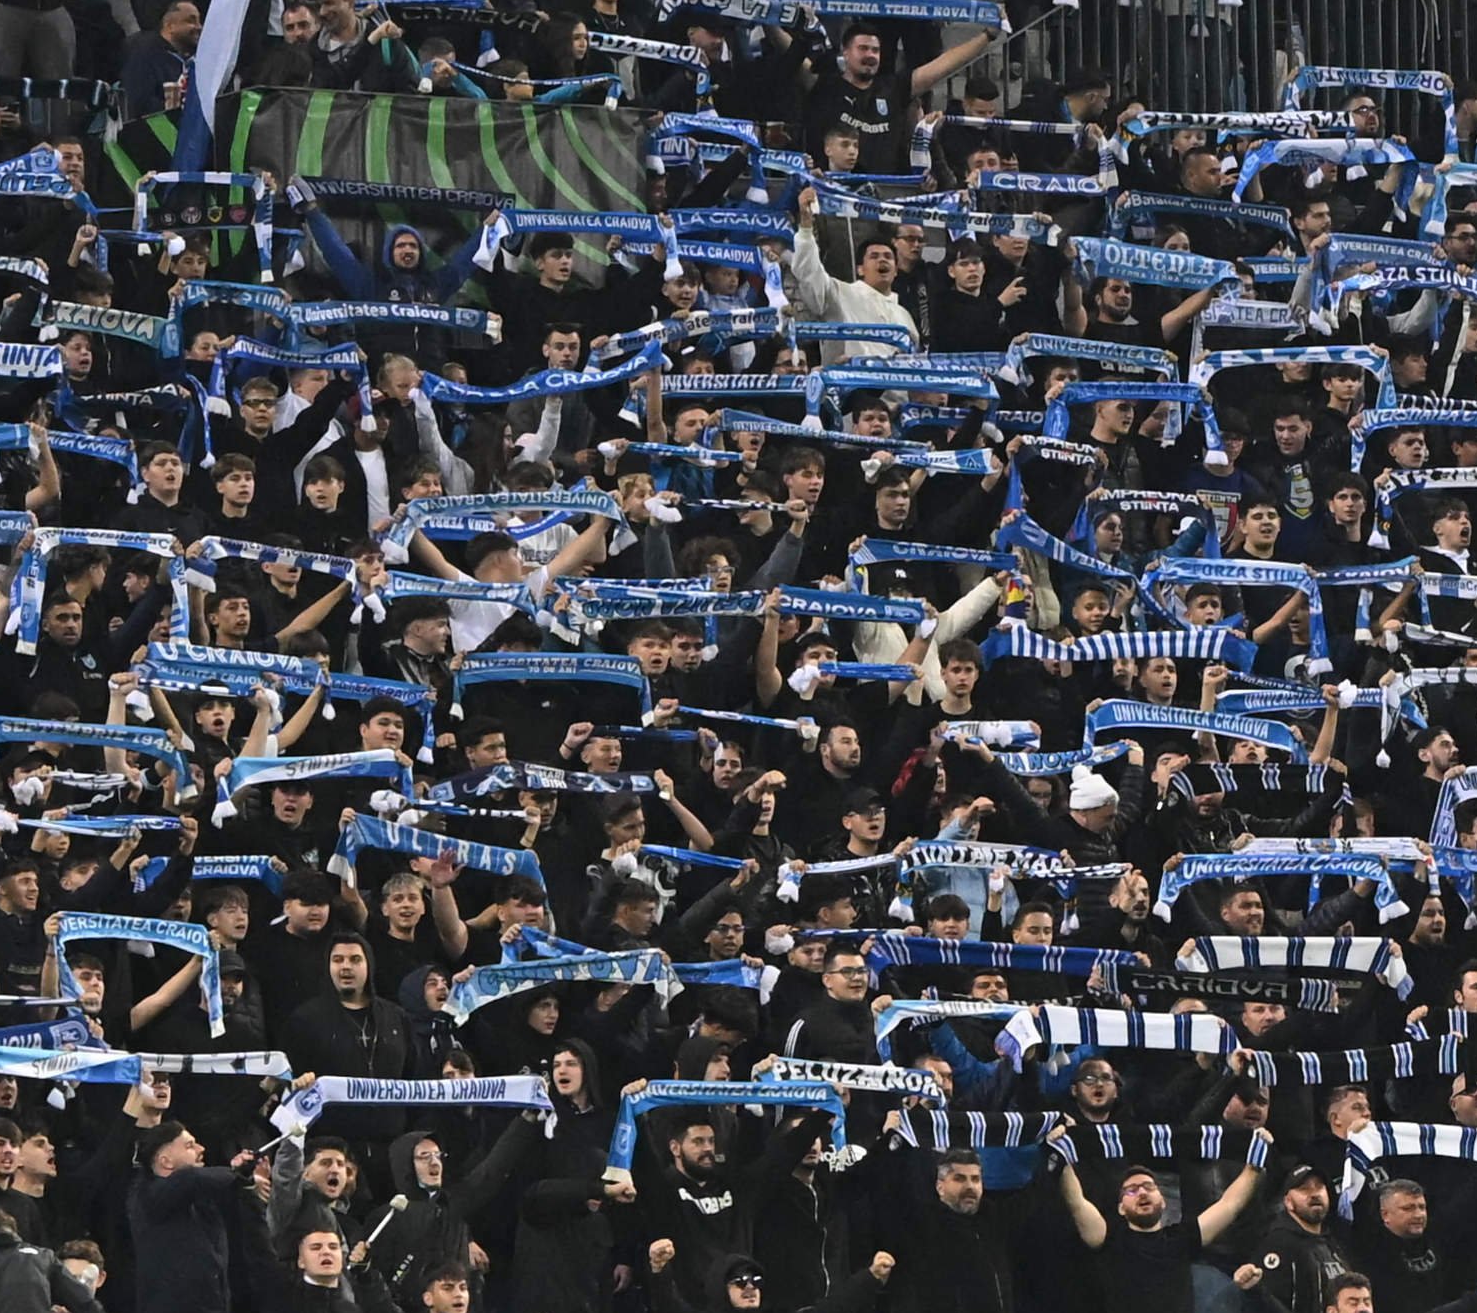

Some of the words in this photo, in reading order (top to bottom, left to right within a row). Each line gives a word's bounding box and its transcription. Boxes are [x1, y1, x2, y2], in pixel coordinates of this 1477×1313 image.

[991, 172, 1105, 192] CRAIO
[1112, 702, 1209, 735] UNIVERSITATEA
[345, 1077, 447, 1102] UNIVERSITATEA
[449, 1078, 507, 1101] CRAIOVA
